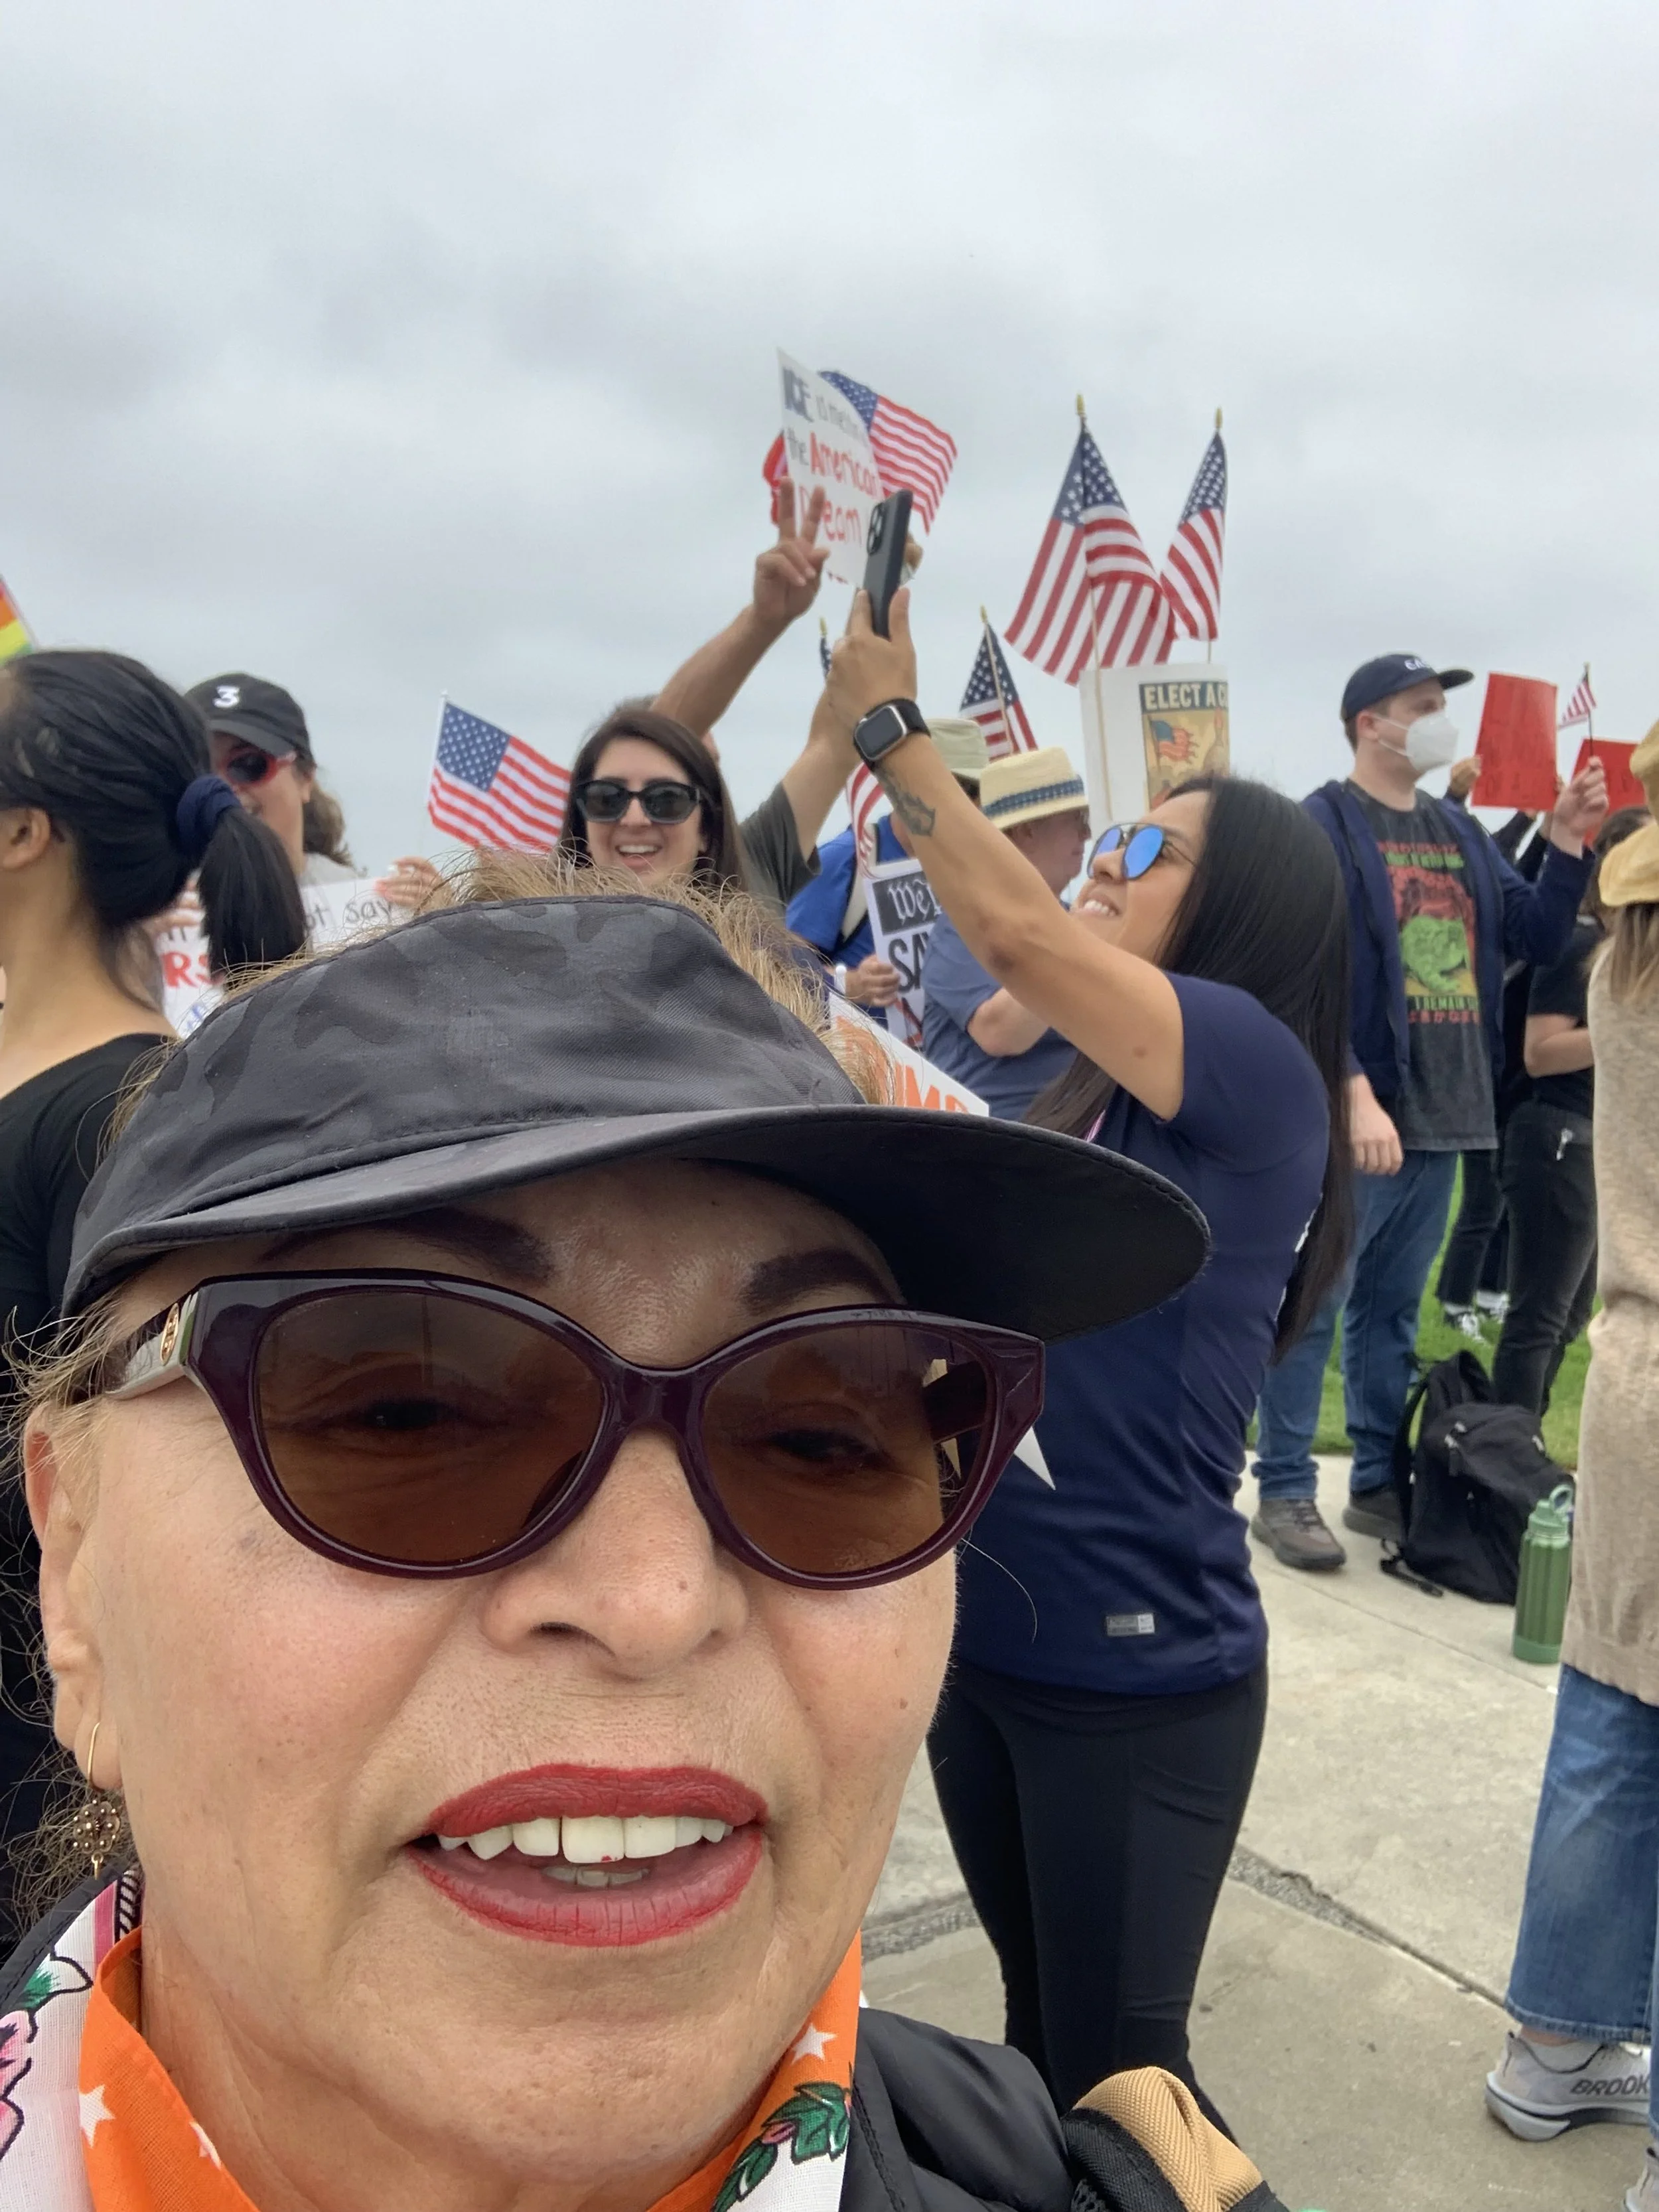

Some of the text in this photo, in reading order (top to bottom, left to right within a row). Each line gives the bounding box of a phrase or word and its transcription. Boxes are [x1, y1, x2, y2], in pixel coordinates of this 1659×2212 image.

[798, 485, 863, 546] Deam
[213, 685, 240, 708] 3
[1143, 683, 1201, 711] ELECT
[1569, 2074, 1650, 2096] BROOK
